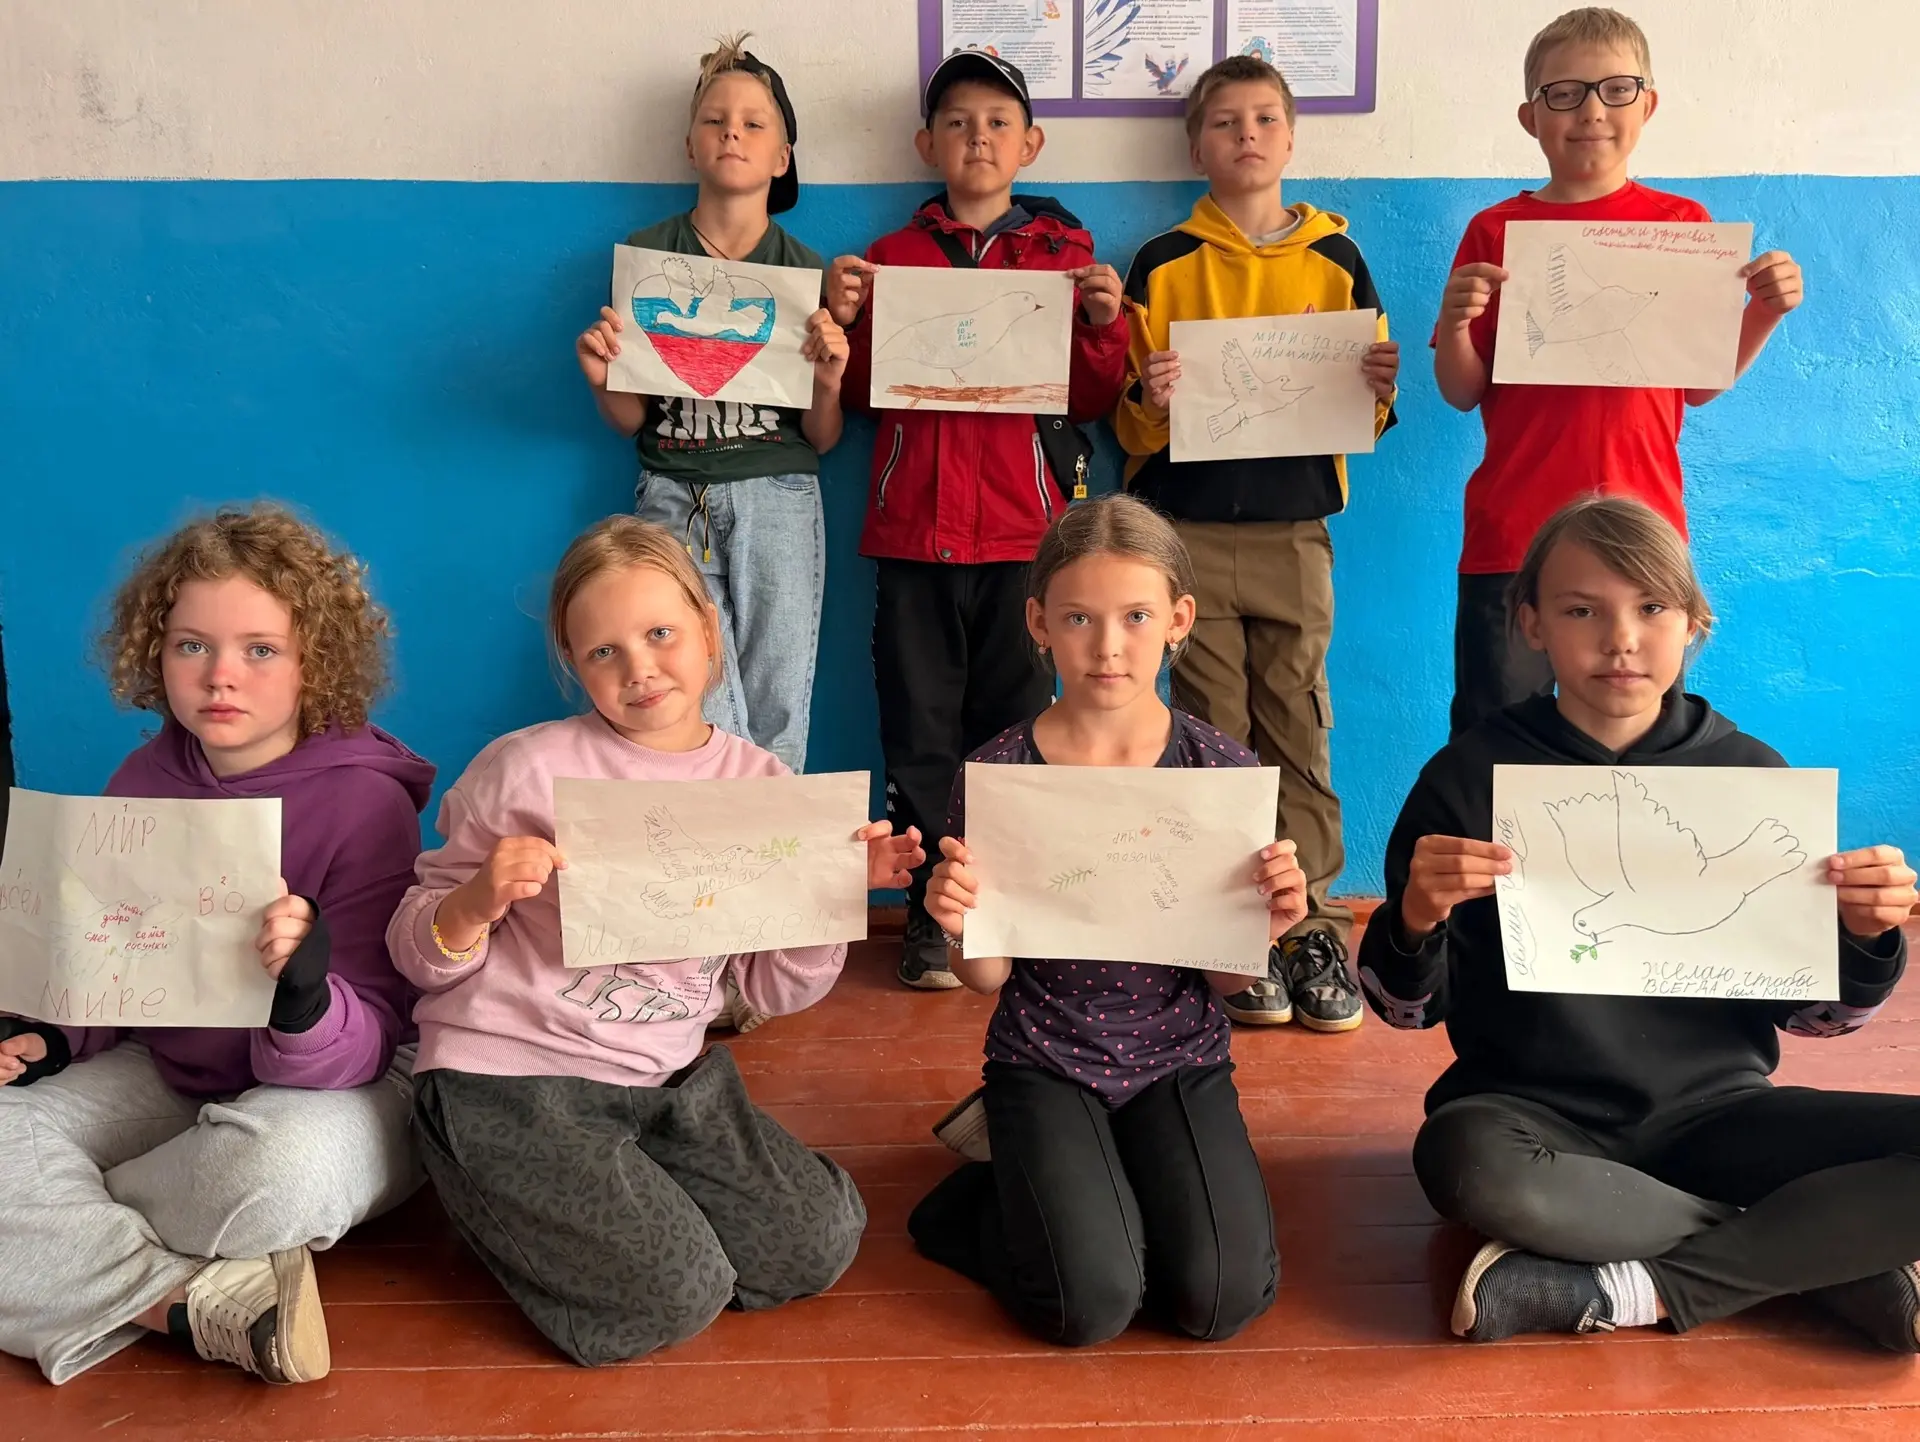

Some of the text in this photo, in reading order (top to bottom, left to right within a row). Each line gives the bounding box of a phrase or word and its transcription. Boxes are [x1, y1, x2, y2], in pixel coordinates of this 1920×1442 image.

[76, 812, 157, 856] МИР
[100, 907, 131, 929] добро
[1641, 960, 1736, 982] Желаю
[1642, 978, 1719, 995] ВСЕГДА
